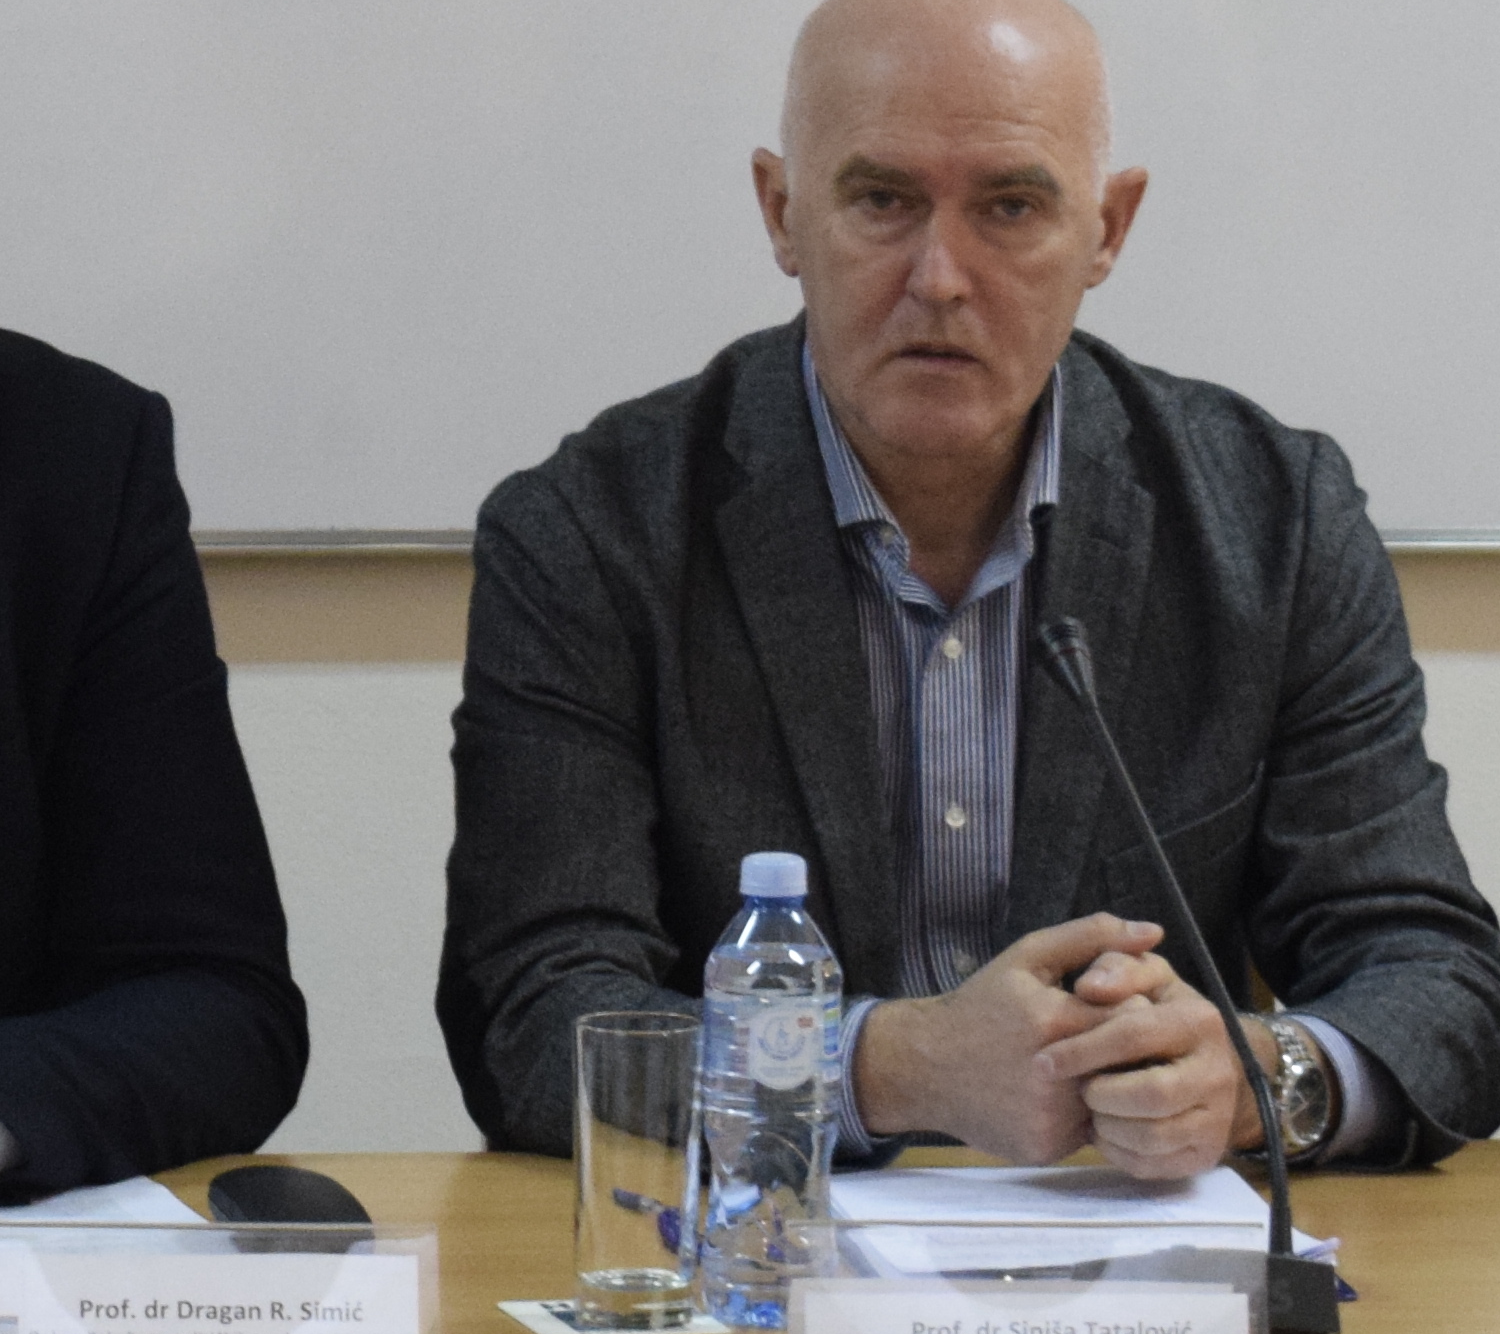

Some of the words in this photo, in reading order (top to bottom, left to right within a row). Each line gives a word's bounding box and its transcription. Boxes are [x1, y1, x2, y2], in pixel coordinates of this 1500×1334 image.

[79, 1300, 136, 1321] Prof.
[144, 1302, 169, 1320] dr
[177, 1302, 261, 1326] Dragan
[271, 1302, 292, 1320] R.
[300, 1300, 363, 1322] Simić
